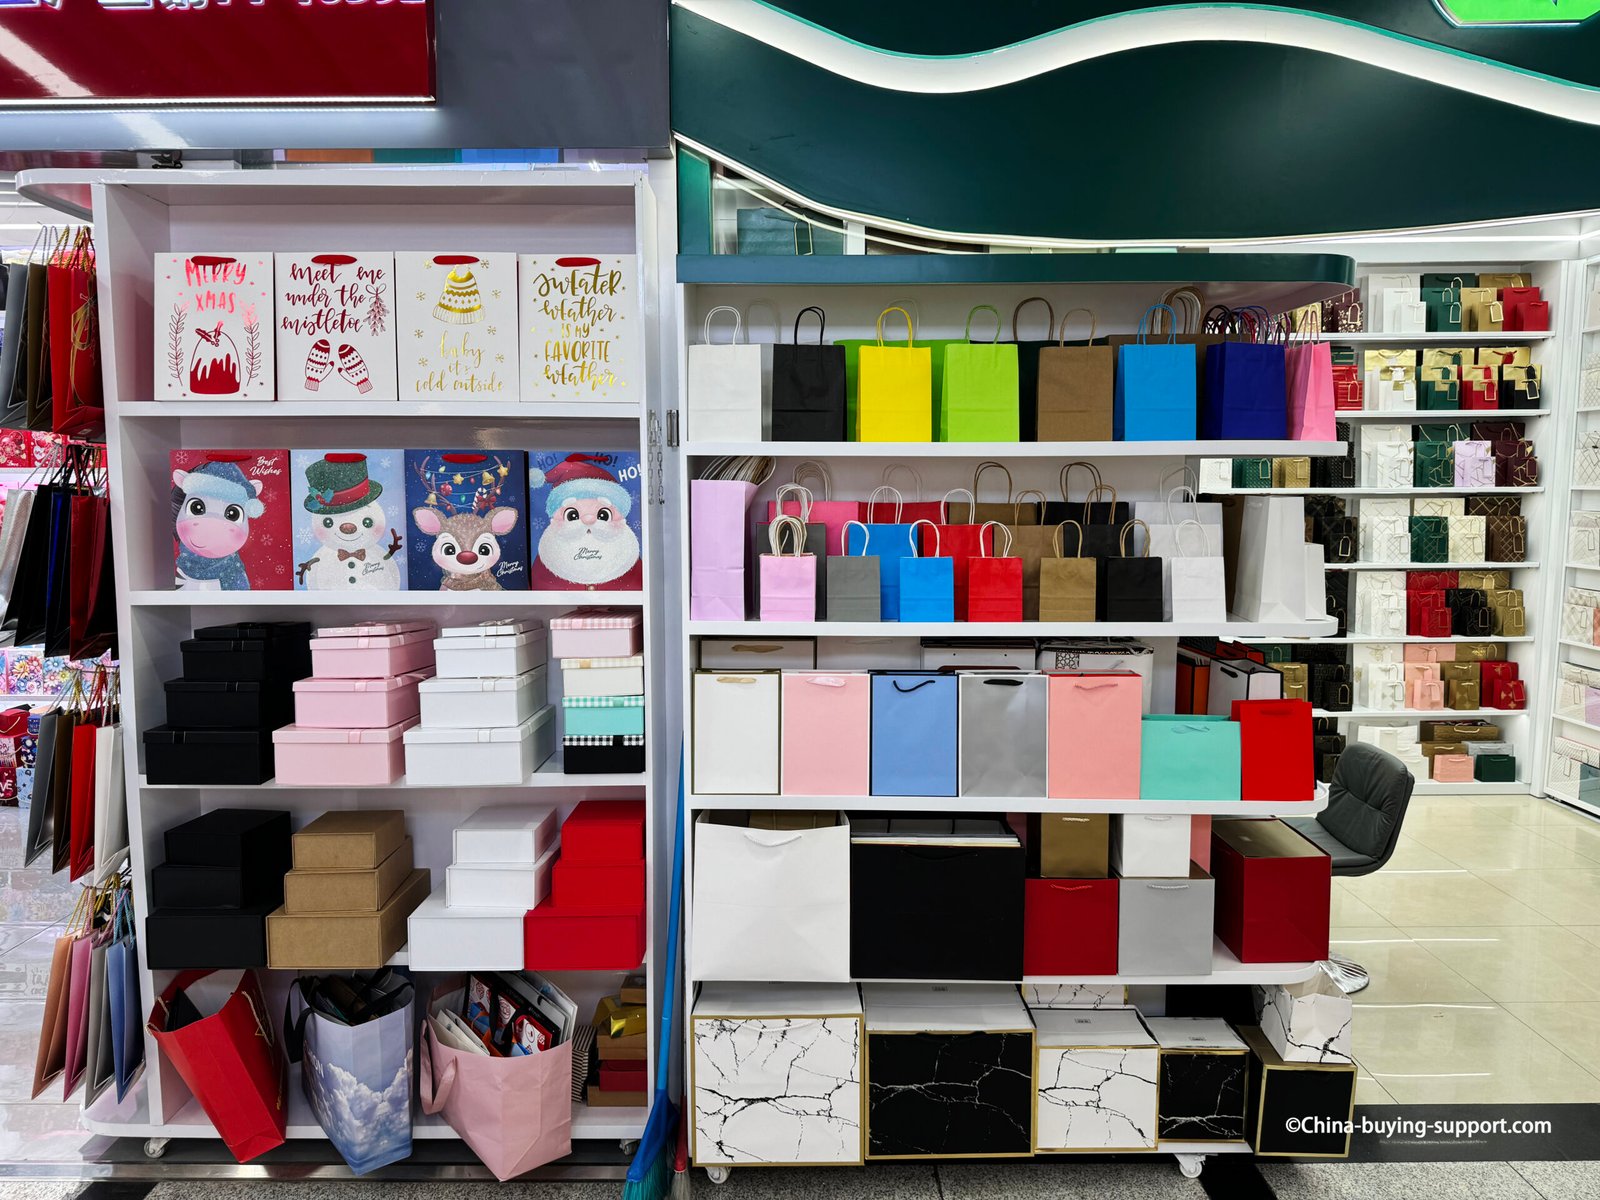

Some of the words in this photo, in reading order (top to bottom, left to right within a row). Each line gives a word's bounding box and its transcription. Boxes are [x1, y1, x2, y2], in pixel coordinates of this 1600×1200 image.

[356, 266, 386, 285] me
[195, 290, 236, 313] XMAS
[284, 283, 332, 308] under
[334, 283, 366, 308] the
[281, 308, 363, 336] mistletoe
[561, 323, 571, 339] IS
[575, 323, 590, 339] MY
[440, 329, 485, 368] baby
[545, 340, 611, 363] FAVORITE
[416, 371, 448, 393] cold
[453, 371, 504, 393] outside
[257, 456, 278, 467] Best
[537, 453, 558, 470] HO!
[250, 466, 282, 476] Wishes
[573, 551, 603, 561] Christmas
[578, 547, 600, 556] Merry
[497, 566, 523, 577] Christmas
[499, 561, 519, 571] Merry
